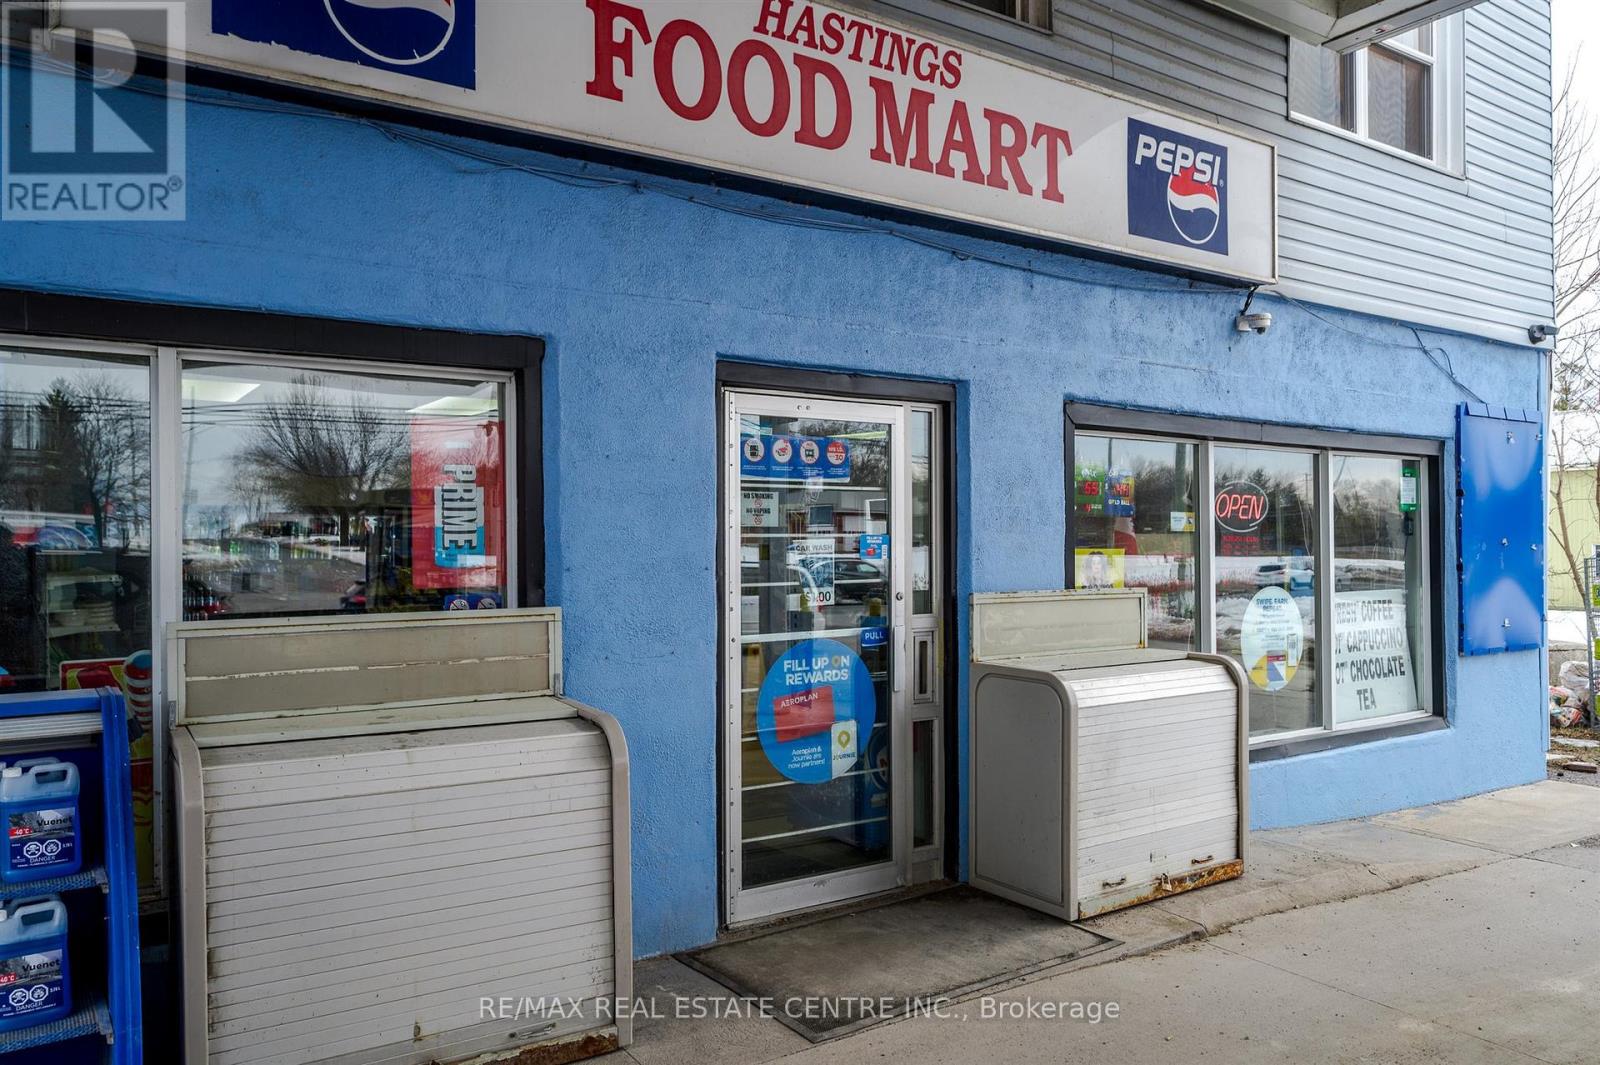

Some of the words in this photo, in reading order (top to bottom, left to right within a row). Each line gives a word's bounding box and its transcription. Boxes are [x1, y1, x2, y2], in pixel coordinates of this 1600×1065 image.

[753, 0, 963, 89] HASTINGS
[586, 0, 852, 150] FOOD
[869, 77, 1074, 204] MART
[443, 464, 478, 550] PRIME
[1215, 493, 1265, 520] OPEN
[1360, 599, 1394, 621] COFFEE
[865, 632, 884, 640] PULL
[1346, 627, 1404, 653] CAPPUCCINO
[783, 658, 810, 672] FILL
[812, 657, 830, 669] UP
[831, 655, 850, 667] ON
[1335, 661, 1345, 684] OT
[1350, 655, 1406, 682] CHOCOLATE
[785, 669, 849, 686] REWARDS
[780, 692, 818, 708] AEROPLAN
[1356, 687, 1377, 711] TEA
[36, 816, 73, 827] Vuenet
[29, 855, 56, 864] DANGER
[22, 959, 60, 971] Vuenet
[15, 1001, 43, 1011] DANGER
